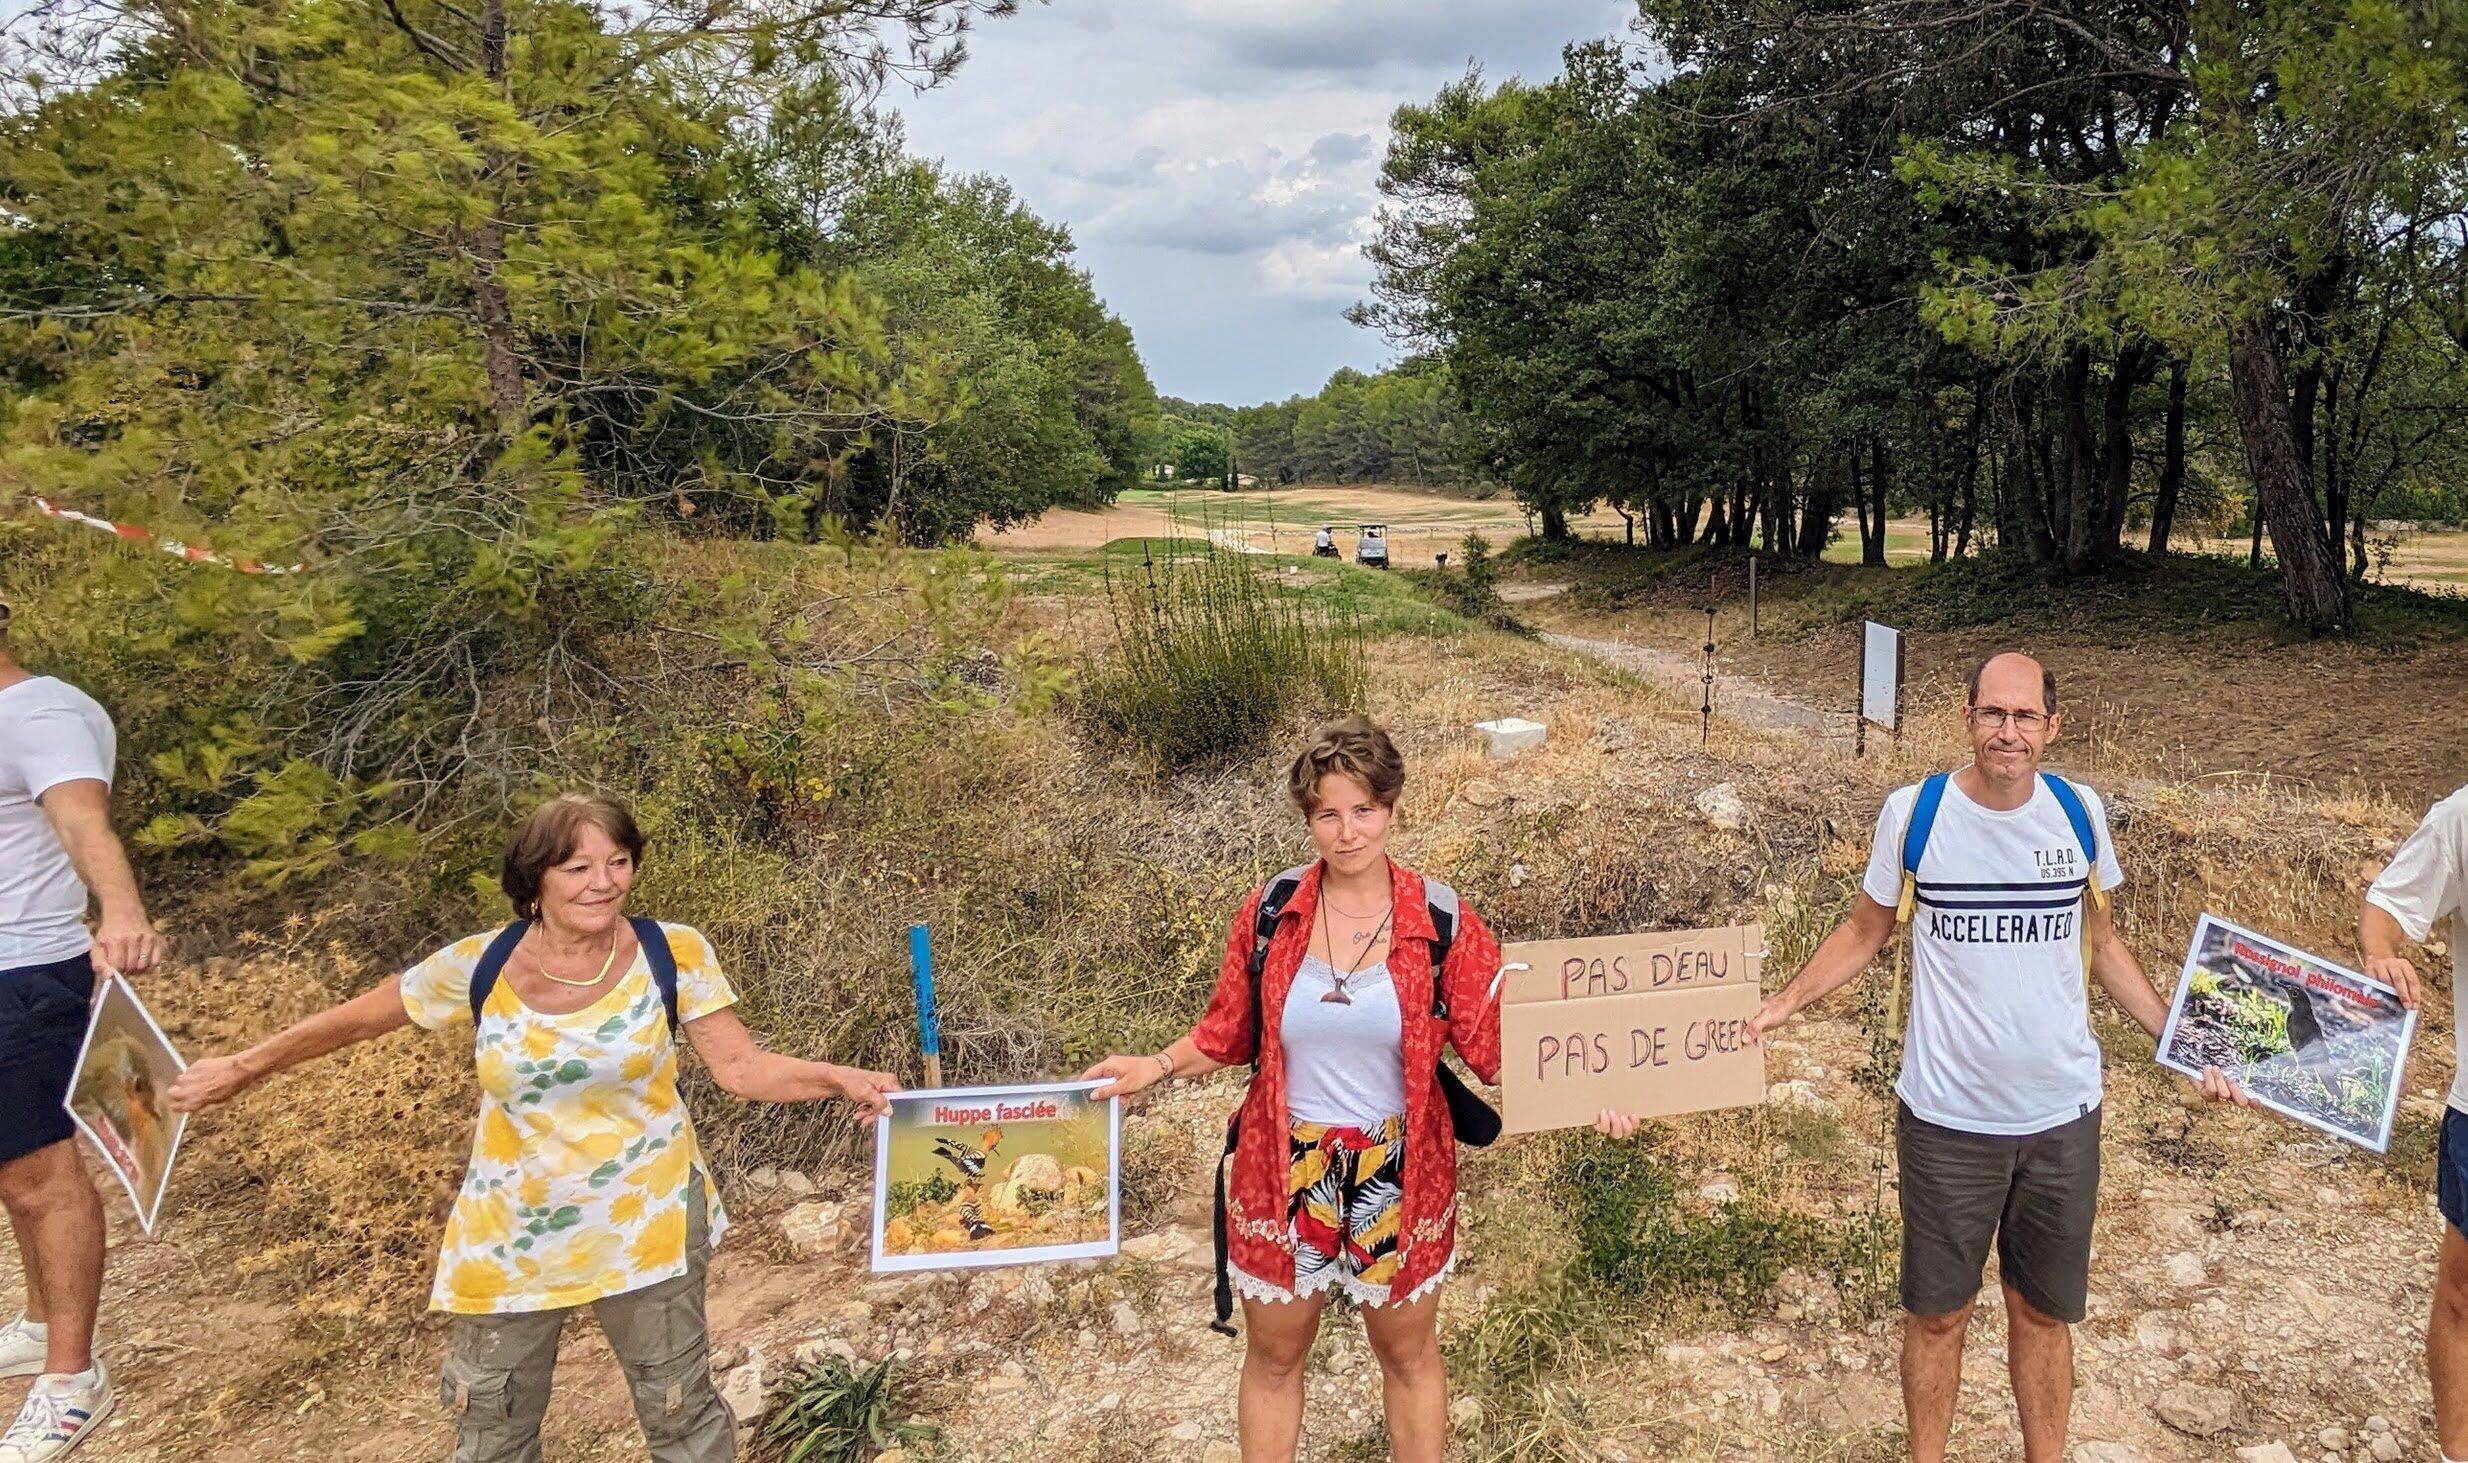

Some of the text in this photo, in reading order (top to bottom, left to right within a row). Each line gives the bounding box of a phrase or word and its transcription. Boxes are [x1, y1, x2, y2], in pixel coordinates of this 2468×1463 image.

[1931, 912, 2073, 943] ACCELERATED
[1561, 947, 1727, 1000] PAS D'EAU
[1538, 1032, 1611, 1081] PAS
[1629, 1027, 1668, 1068] DE
[935, 1106, 991, 1125] Huppe
